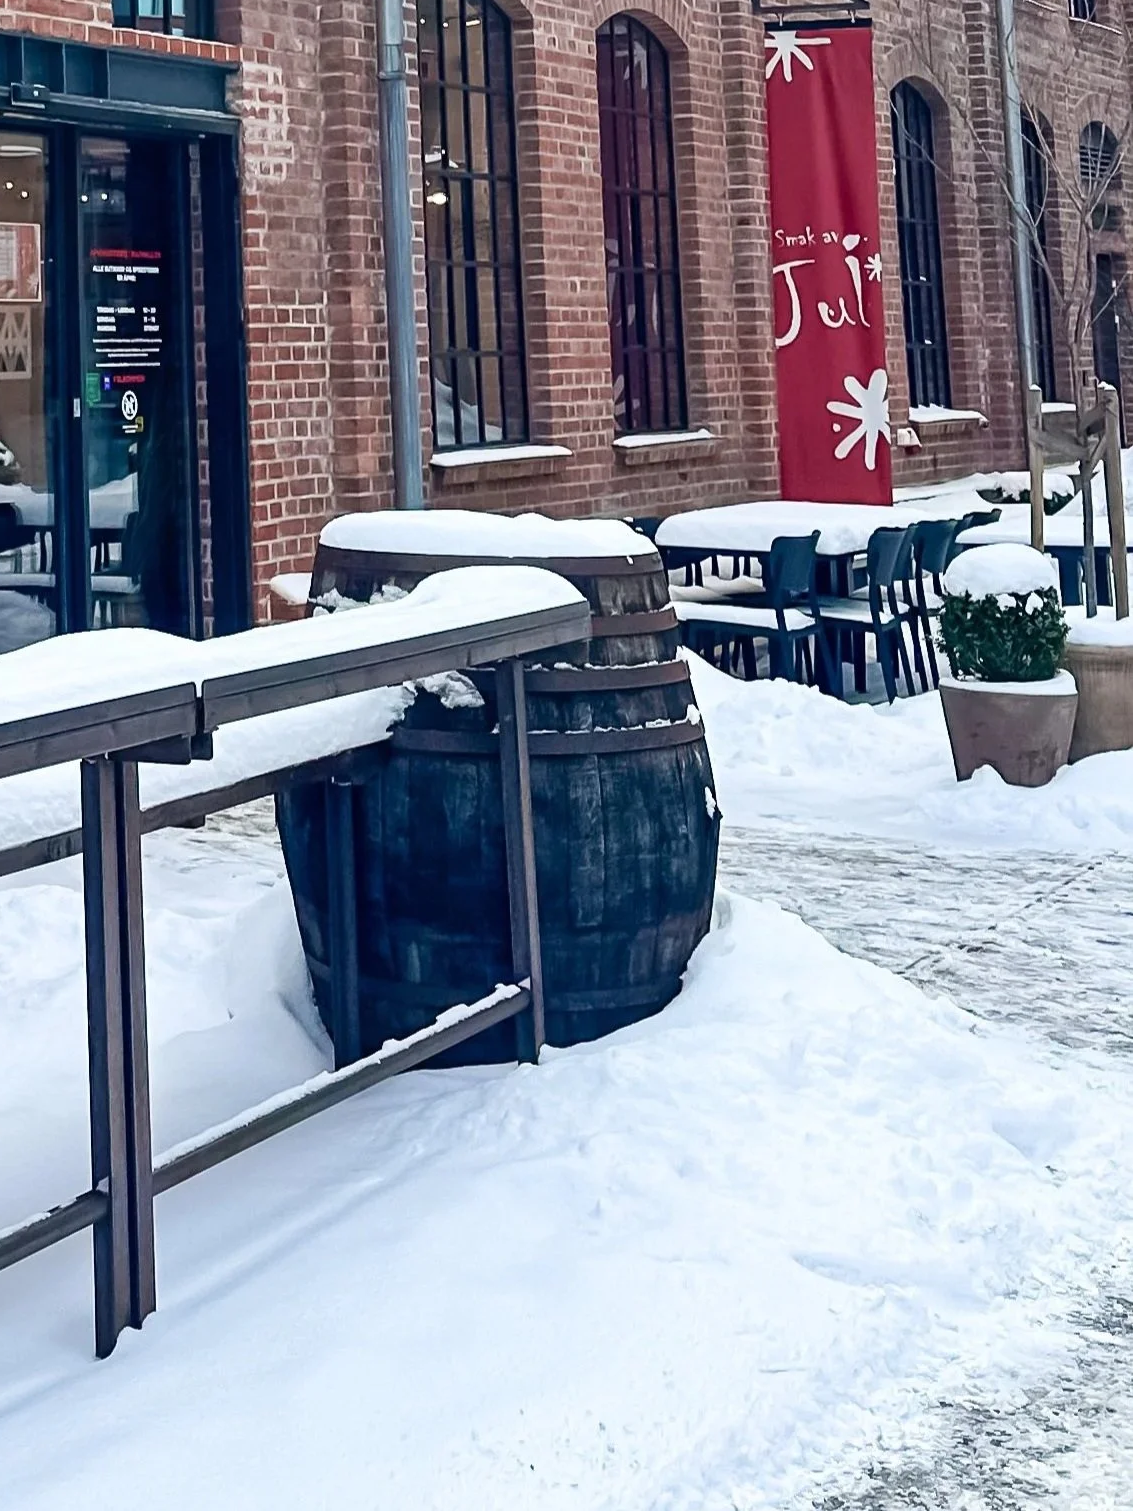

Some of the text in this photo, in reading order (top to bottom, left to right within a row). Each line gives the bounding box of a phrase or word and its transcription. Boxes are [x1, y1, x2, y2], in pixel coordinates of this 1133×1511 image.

[775, 226, 840, 247] Smak av
[772, 255, 871, 347] Jul
